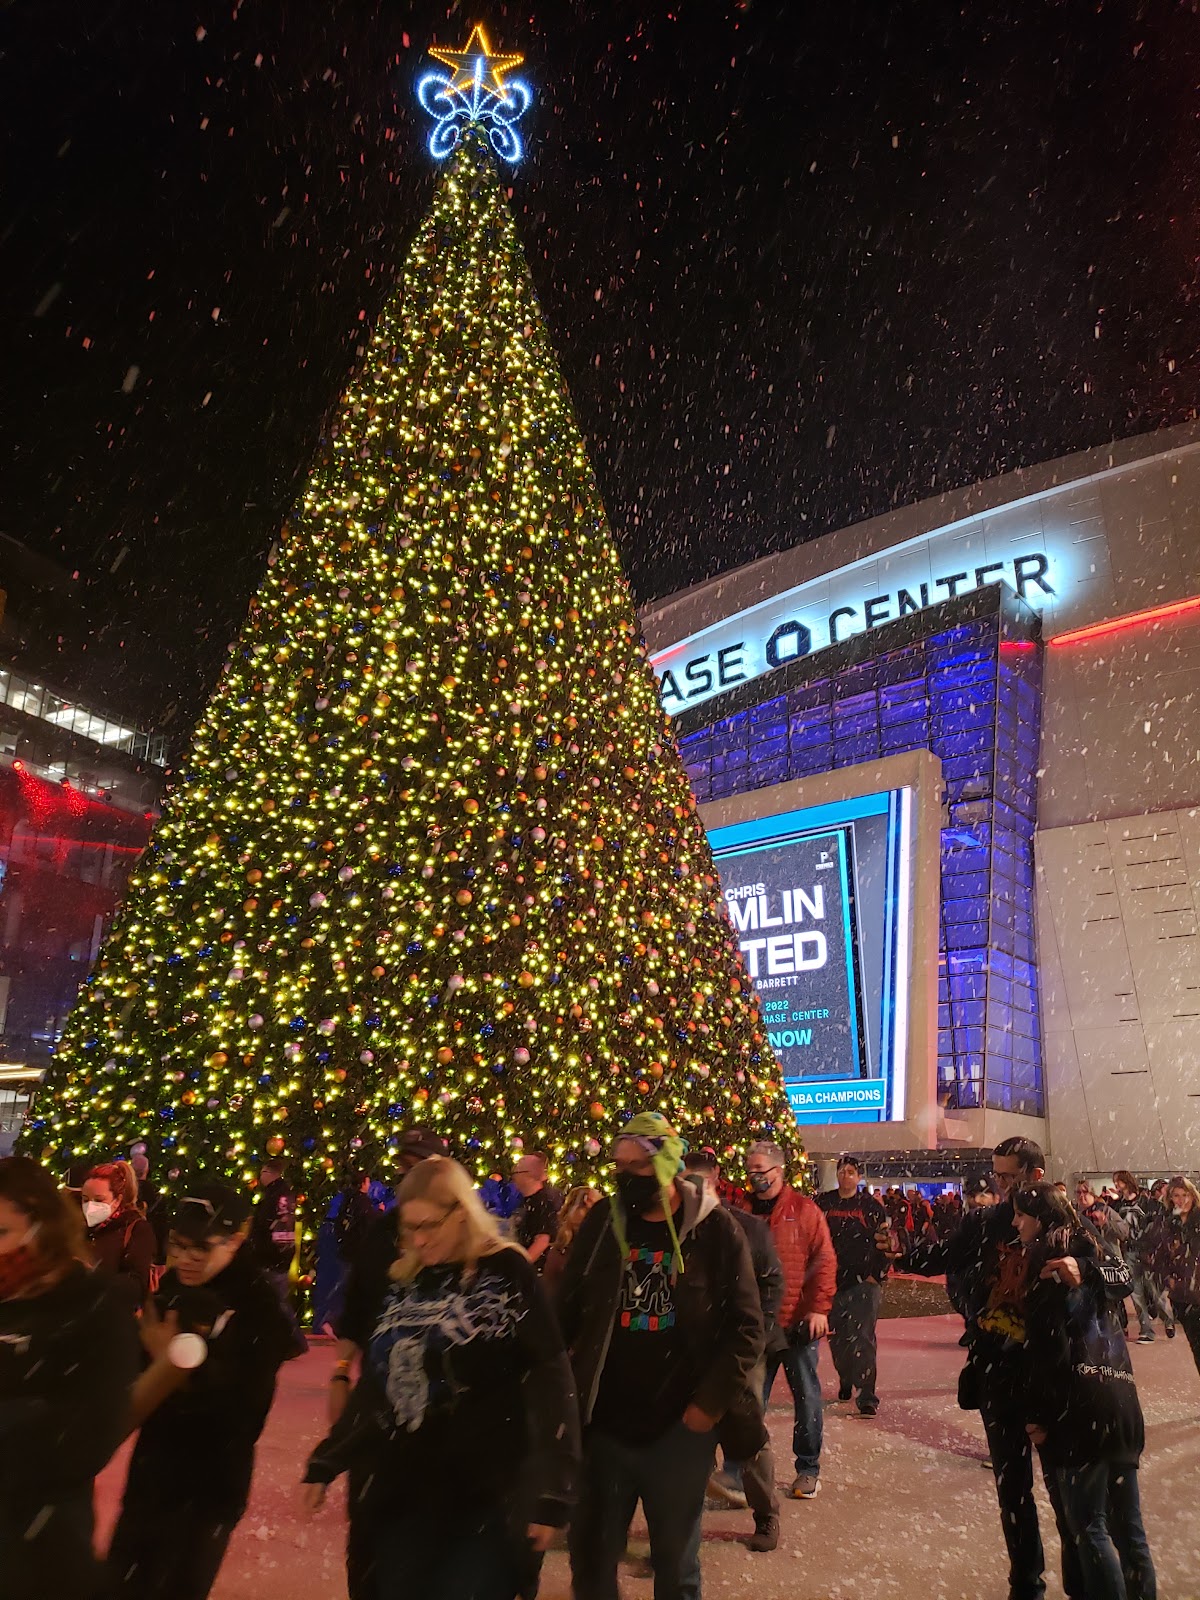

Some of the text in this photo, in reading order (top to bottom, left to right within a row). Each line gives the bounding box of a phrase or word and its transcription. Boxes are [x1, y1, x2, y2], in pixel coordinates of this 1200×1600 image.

[660, 641, 748, 703] ASE
[724, 882, 766, 901] CHRIS
[728, 884, 825, 932] MLIN
[739, 930, 828, 978] TED
[756, 975, 799, 990] BARRETT
[765, 1000, 789, 1012] 2022
[792, 1008, 829, 1022] CENTER
[768, 1028, 812, 1048] NOW
[791, 1088, 881, 1105] NBA CHAMPIONS
[1076, 1362, 1099, 1376] RIDE
